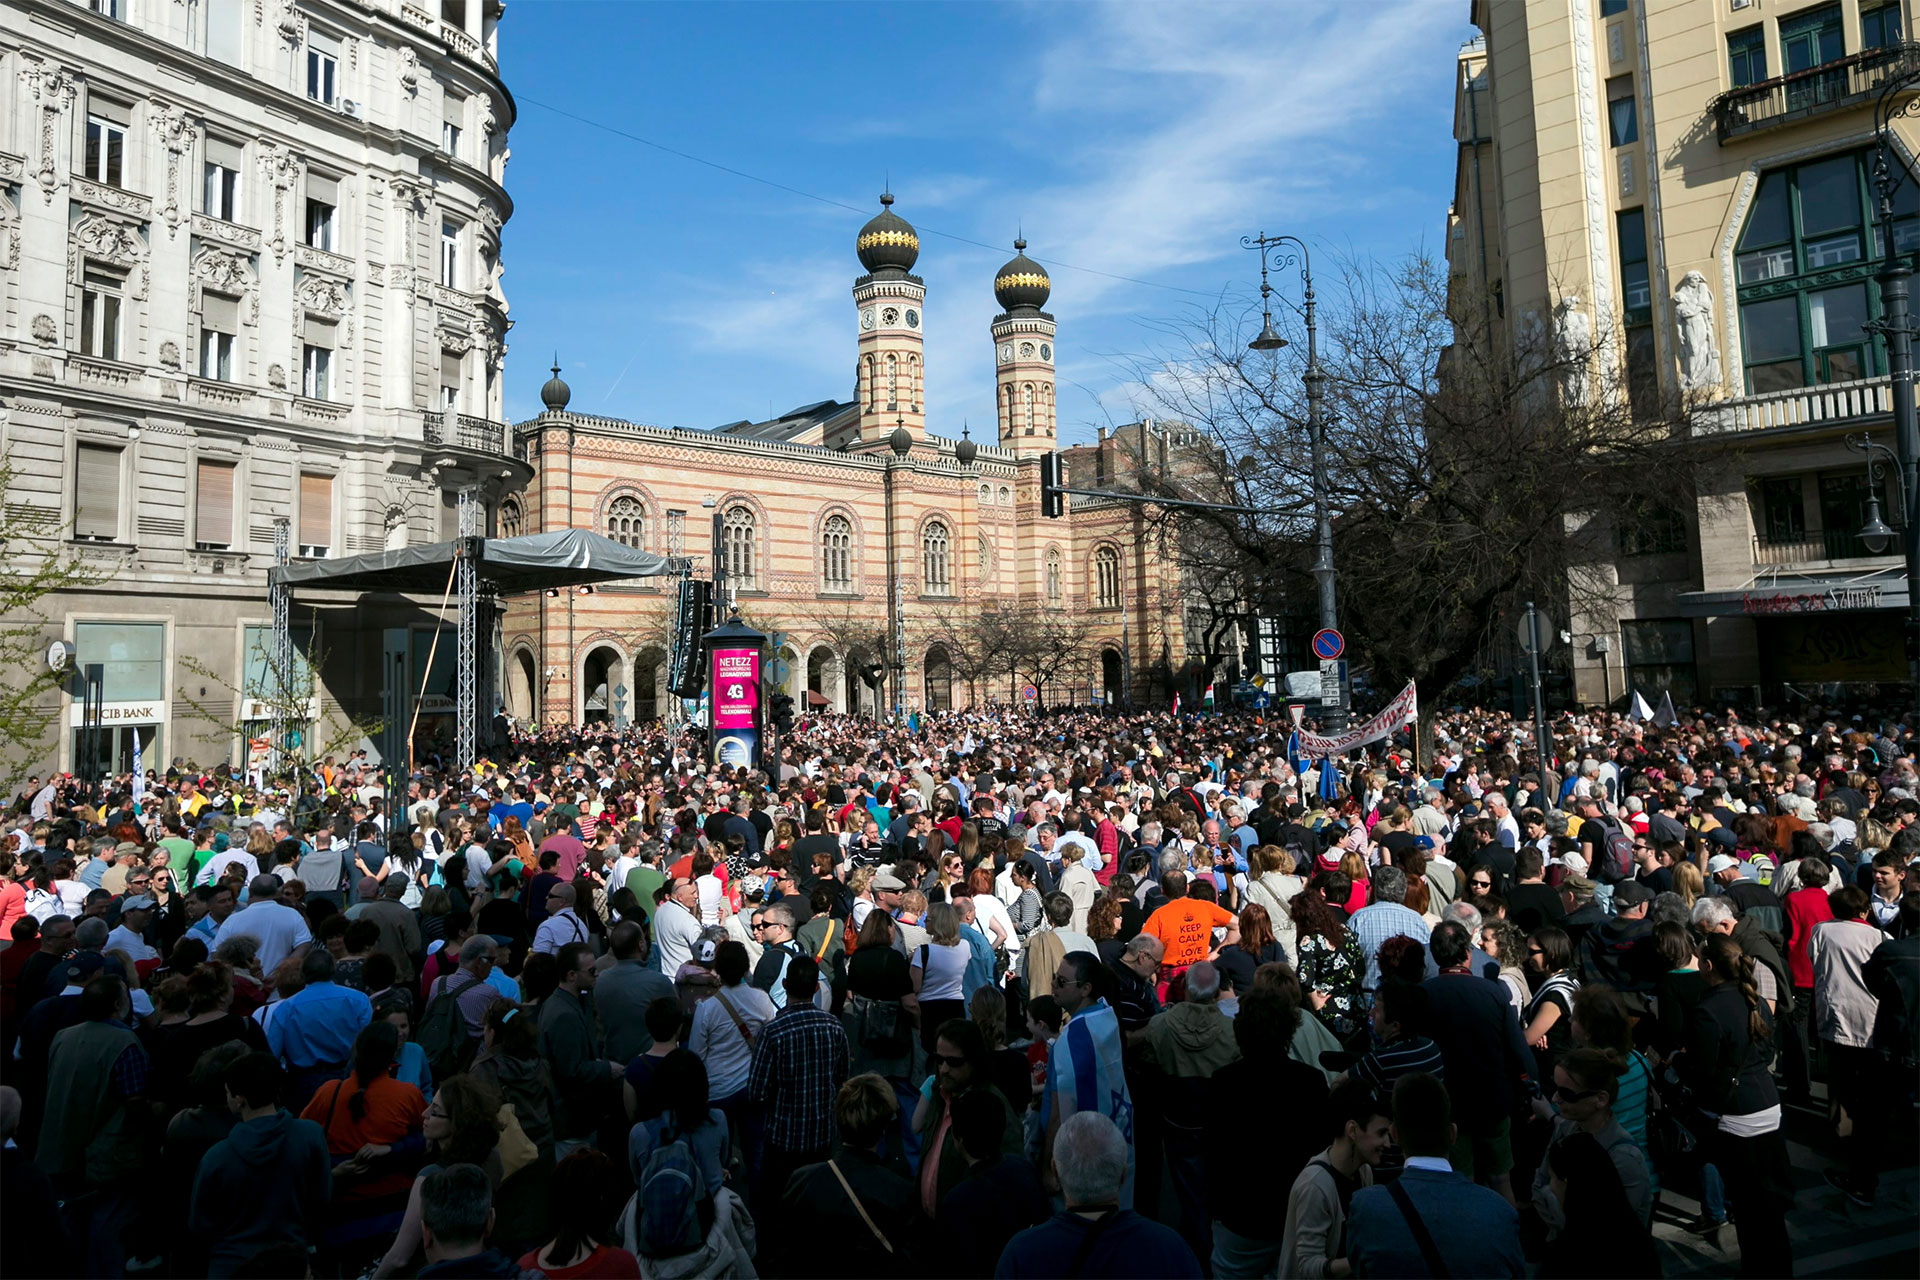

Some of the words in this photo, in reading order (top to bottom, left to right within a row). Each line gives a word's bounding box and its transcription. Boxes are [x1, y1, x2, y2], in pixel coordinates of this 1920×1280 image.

[720, 657, 751, 666] NETEZZ
[727, 684, 744, 699] 4G
[101, 708, 121, 719] CIB
[123, 708, 154, 718] BANK
[1180, 923, 1202, 933] KEEP
[1179, 933, 1204, 943] CALM
[1181, 947, 1202, 957] LOVE
